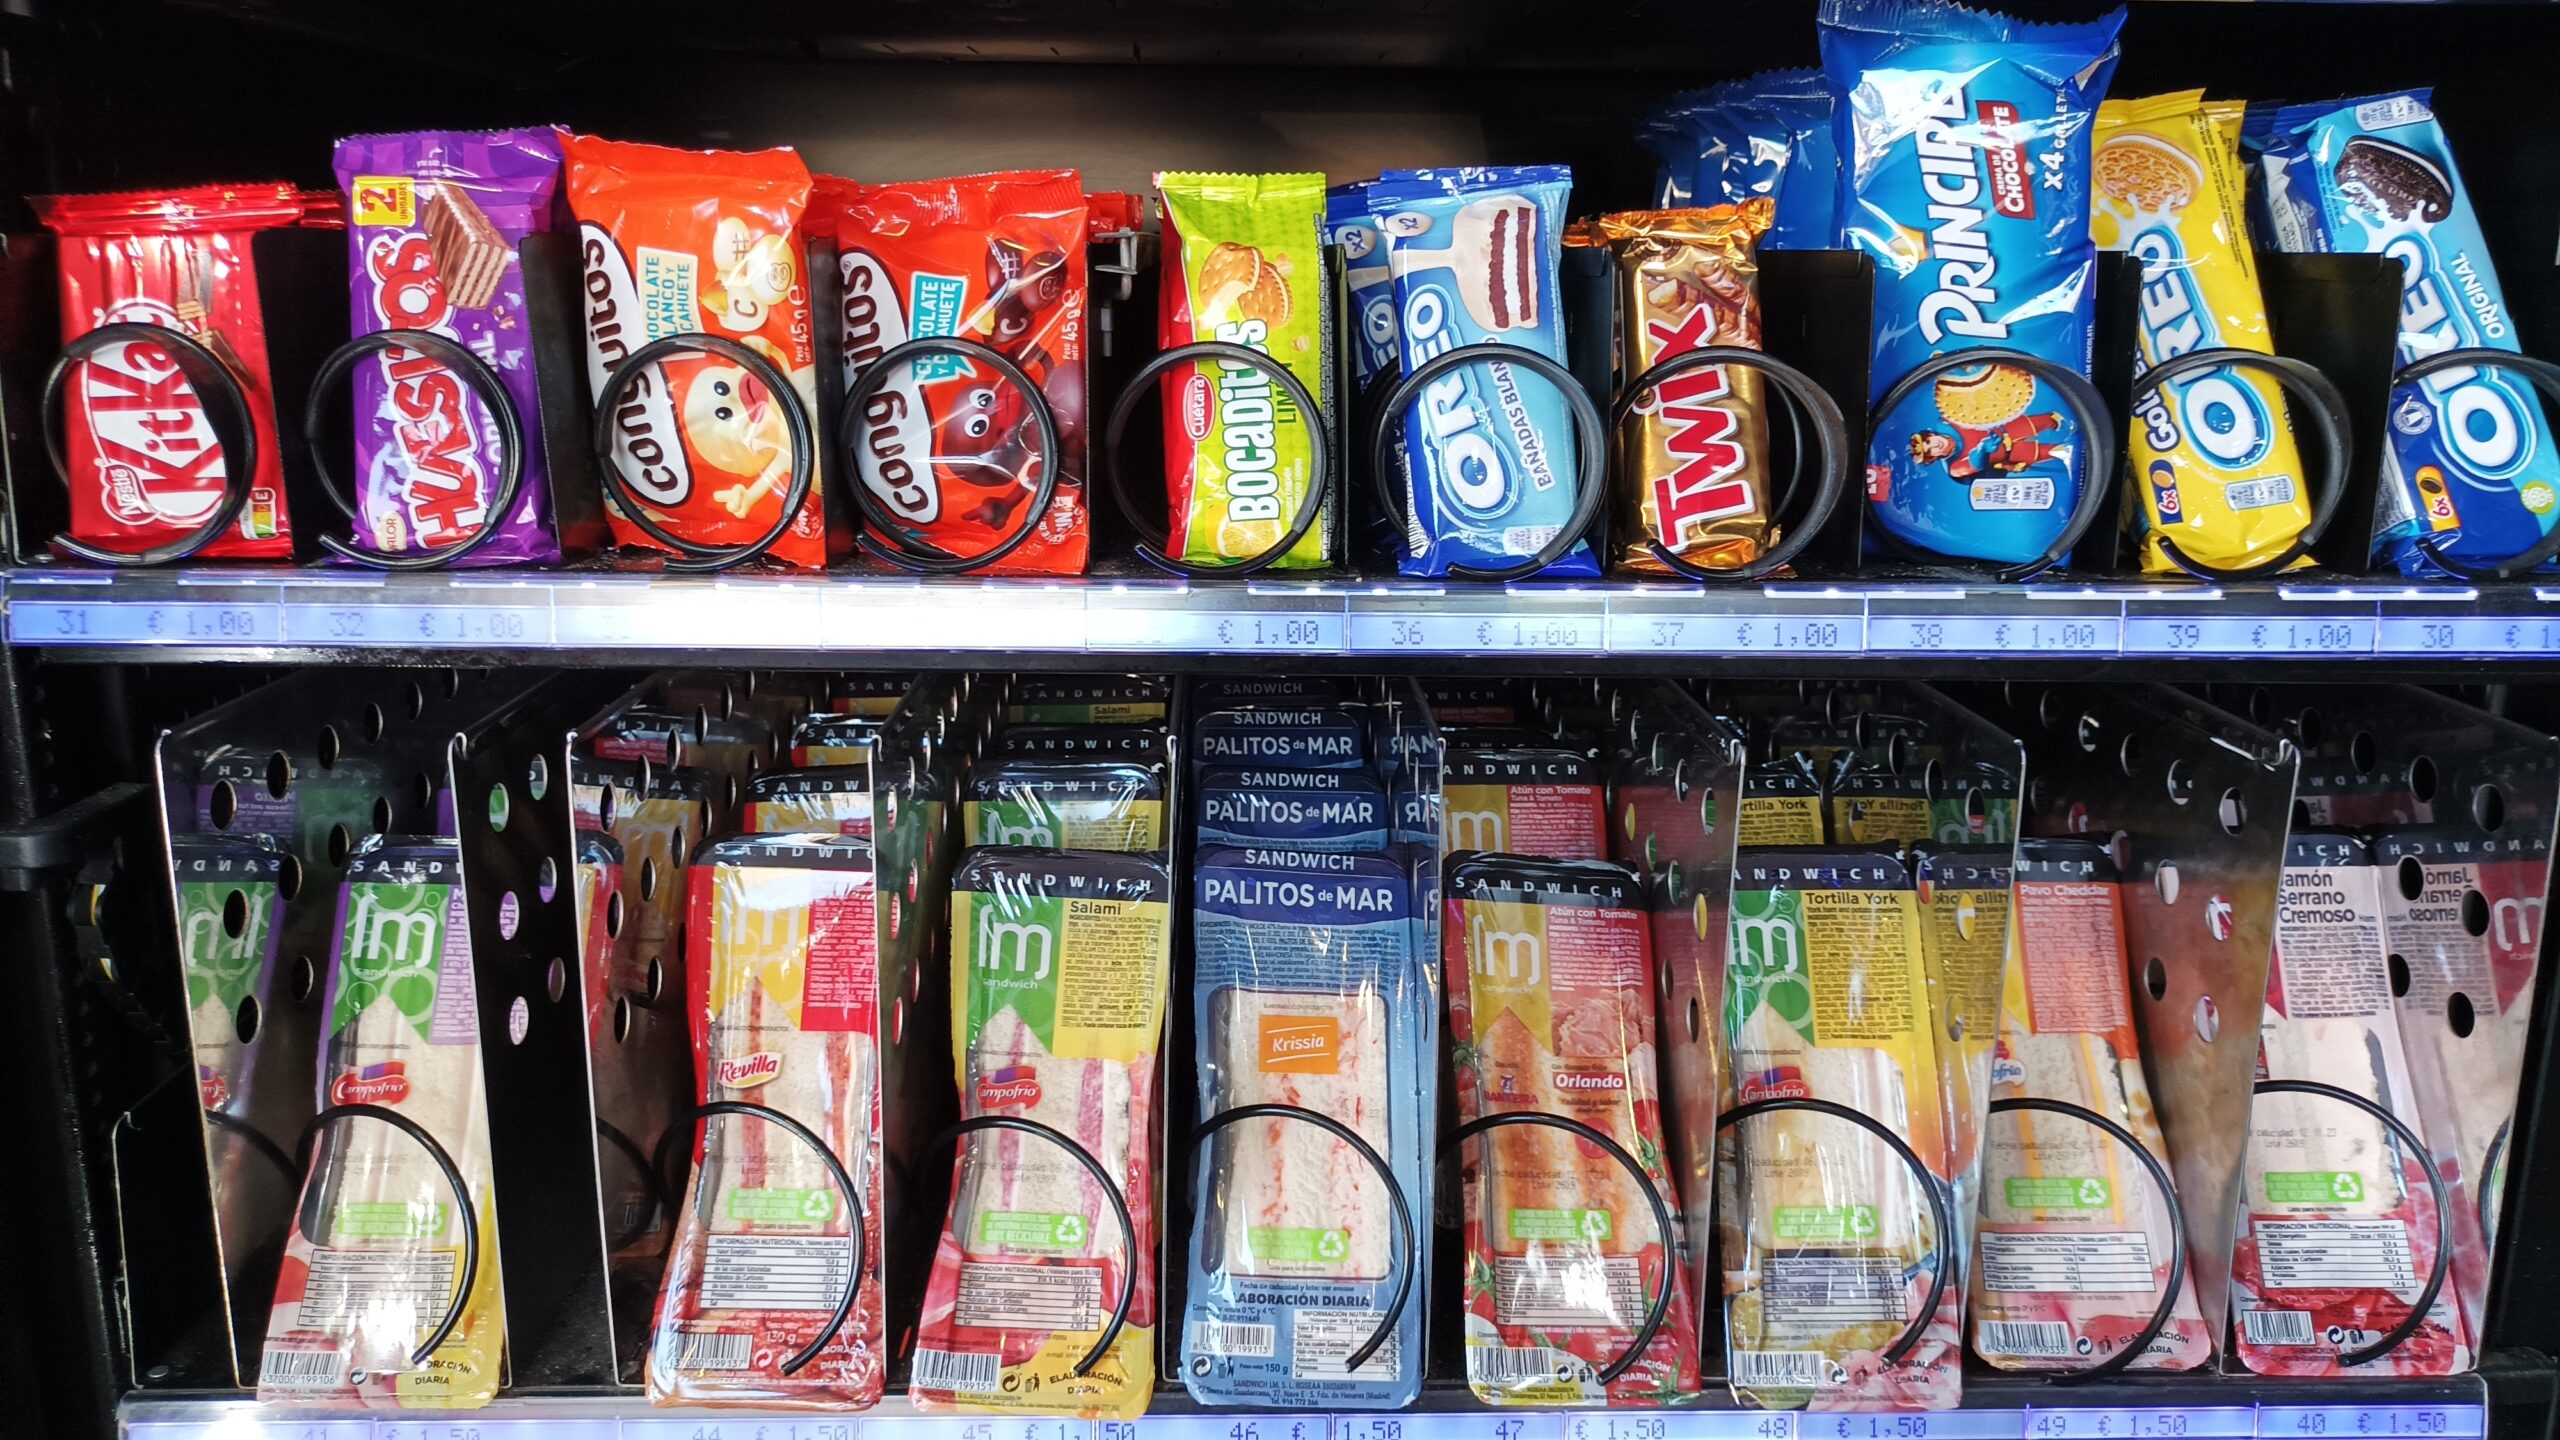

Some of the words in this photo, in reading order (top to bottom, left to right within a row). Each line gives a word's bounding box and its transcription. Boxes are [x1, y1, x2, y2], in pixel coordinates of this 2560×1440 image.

[1992, 106, 2025, 213] CHOCOLTE
[362, 185, 397, 213] 2
[646, 257, 660, 343] HOCOLATE
[676, 264, 690, 334] CAHUETE
[2456, 251, 2505, 339] ORIGINAL
[664, 279, 677, 337] LANCO
[915, 281, 938, 382] CHCOLATE
[1061, 321, 1079, 343] 45
[2132, 234, 2259, 460] OREO
[1485, 337, 1519, 407] BLANO
[1192, 378, 1206, 437] Cuétara
[1409, 292, 1505, 508] OREO
[57, 610, 88, 635] 31
[146, 611, 164, 635] €
[187, 611, 255, 637] 1,00
[329, 610, 365, 636] 32
[419, 612, 434, 636] €
[457, 612, 524, 637] 1,00
[1217, 620, 1233, 645] €
[1254, 620, 1320, 646] 1,00
[1392, 620, 1424, 645] 36
[1477, 621, 1493, 645] €
[1513, 620, 1579, 646] 1,00
[1651, 621, 1684, 647] 37
[1737, 623, 1752, 647] €
[1773, 622, 1838, 648] 1,00
[1911, 623, 1943, 648] 38
[1995, 624, 2011, 648] €
[2031, 624, 2095, 649] 1,00
[2167, 624, 2200, 648] 39
[2251, 625, 2267, 648] €
[2287, 624, 2352, 649] 1,00
[2422, 624, 2454, 649] 30
[2505, 625, 2521, 648] €
[1223, 682, 1302, 696] SANDWICH
[1094, 705, 1131, 714] Salami
[1234, 712, 1321, 725] SANDWICH
[1007, 738, 1150, 749] SANDWICH
[1203, 737, 1290, 756] PALITOS
[1293, 741, 1305, 750] de
[1307, 737, 1353, 756] MAR
[1240, 772, 1340, 788] SANDWICH
[1510, 785, 1533, 795] Atún
[1535, 787, 1554, 795] con
[1556, 786, 1591, 796] Tomate
[1205, 800, 1303, 824] PALITOS
[1306, 806, 1320, 818] de
[1322, 802, 1373, 824] MAR
[1778, 800, 1808, 811] York
[1244, 848, 1356, 870] SANDWICH
[970, 868, 1152, 892] SANDWICH
[1455, 875, 1622, 899] SANDWICH
[2020, 885, 2050, 896] Pavo
[1204, 878, 1314, 908] PALITOS
[1317, 890, 1333, 902] de
[1335, 885, 1393, 912] MAR
[1805, 892, 1859, 905] Tortilla
[1864, 892, 1898, 905] York
[2279, 889, 2345, 905] Serrano
[1070, 900, 1121, 916] Salami
[1550, 906, 1573, 917] Atún
[1577, 909, 1597, 918] con
[1600, 907, 1637, 920] Tomate
[2279, 907, 2355, 923] Cremoso
[1272, 1033, 1326, 1053] Krissia
[719, 1054, 779, 1084] Revilla
[1555, 1073, 1624, 1089] Orlando
[980, 1085, 1038, 1102] ampofrio
[1228, 1292, 1319, 1306] LABORACIÓN
[1322, 1294, 1371, 1307] DIARIA
[766, 1330, 784, 1343] 130
[1264, 1363, 1280, 1373] 150
[1282, 1365, 1288, 1375] g
[414, 1375, 450, 1386] DIARIA
[962, 1424, 992, 1440] 45
[1230, 1422, 1259, 1440] 46
[1344, 1421, 1402, 1440] 1,50
[1496, 1420, 1525, 1440] 47
[1575, 1420, 1588, 1440] €
[1608, 1419, 1666, 1440] 1,50
[1758, 1417, 1788, 1439] 48
[1837, 1418, 1850, 1438] €
[1869, 1416, 1927, 1440] 1,50
[2037, 1415, 2066, 1436] 49
[2098, 1416, 2112, 1436] €
[2130, 1415, 2187, 1437] 1,50
[2297, 1413, 2326, 1434] 40
[2357, 1414, 2371, 1434] €
[2390, 1412, 2447, 1434] 1,50
